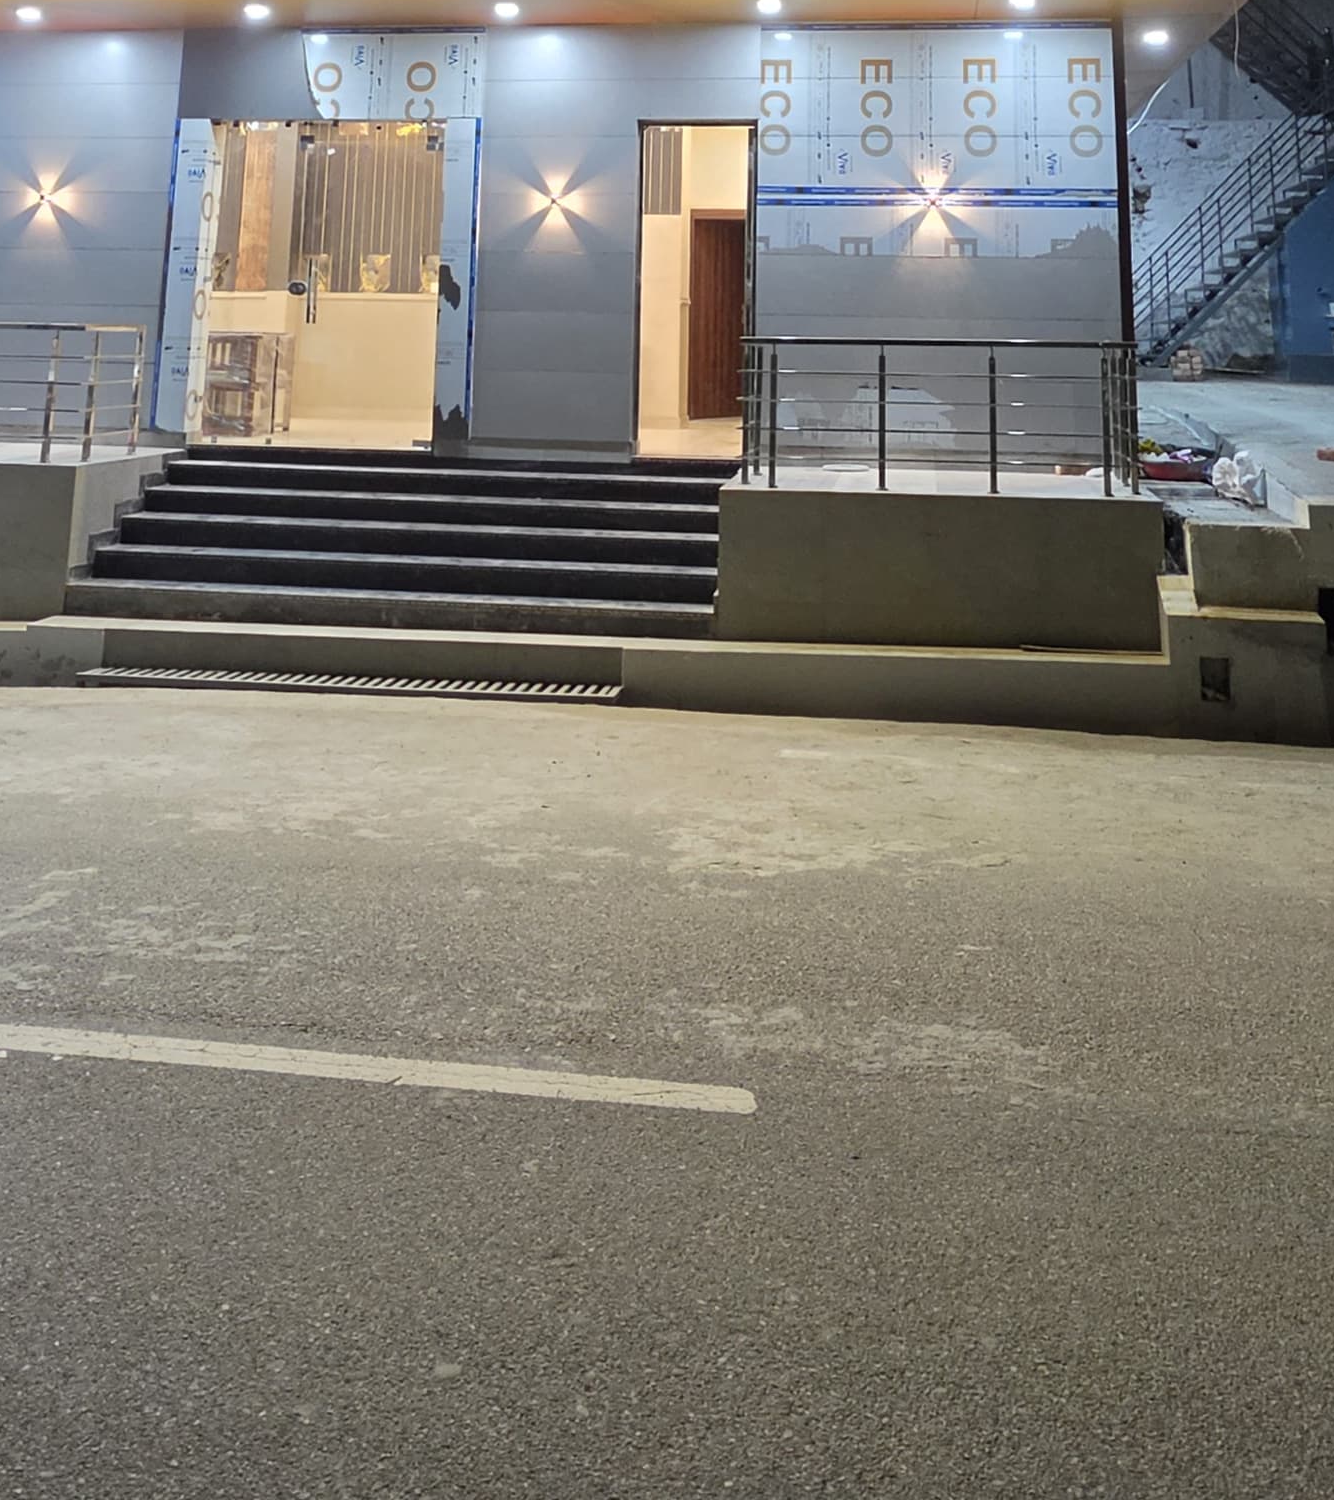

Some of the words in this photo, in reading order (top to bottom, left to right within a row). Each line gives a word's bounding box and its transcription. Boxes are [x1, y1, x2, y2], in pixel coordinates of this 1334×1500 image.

[760, 59, 792, 156] ECO
[860, 58, 893, 157] ECO
[962, 58, 997, 158] ECO
[1066, 57, 1103, 158] ECO
